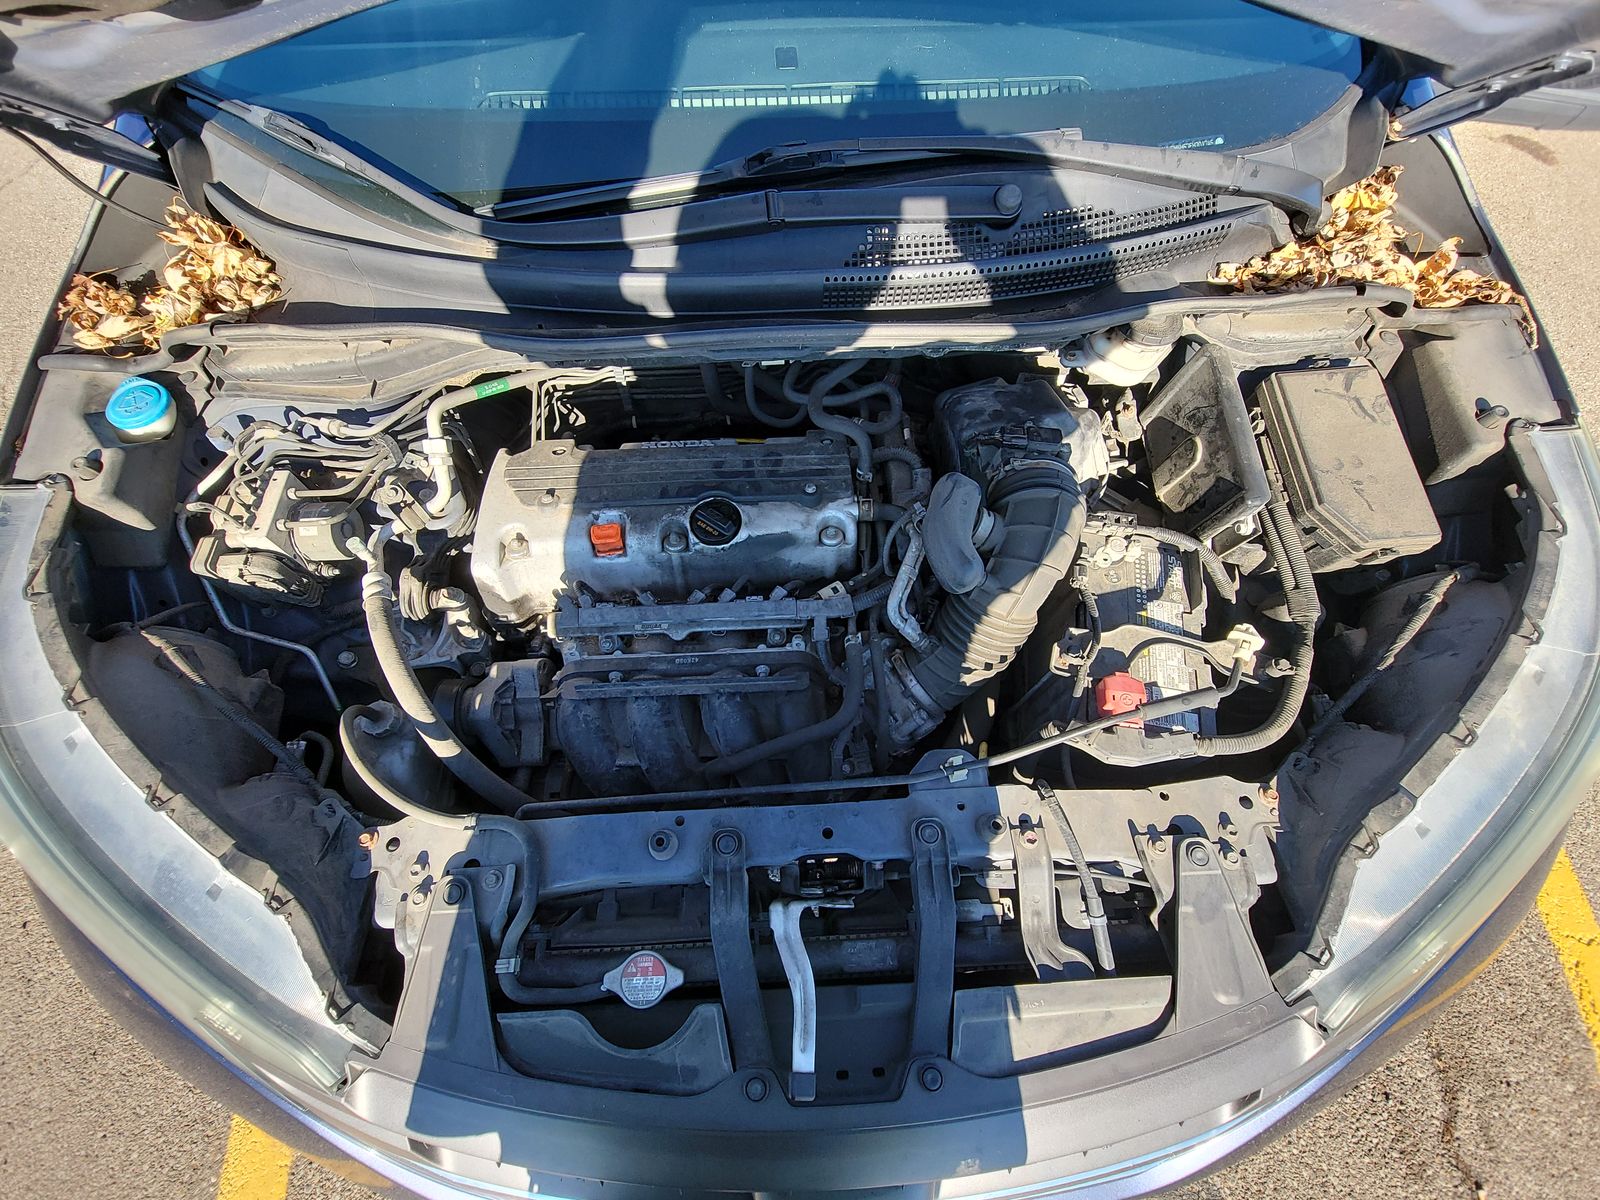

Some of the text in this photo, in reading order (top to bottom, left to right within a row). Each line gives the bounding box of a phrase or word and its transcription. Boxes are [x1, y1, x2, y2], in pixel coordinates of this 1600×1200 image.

[641, 440, 714, 448] HONDA
[1167, 555, 1176, 587] START
[1173, 560, 1183, 589] SUPER
